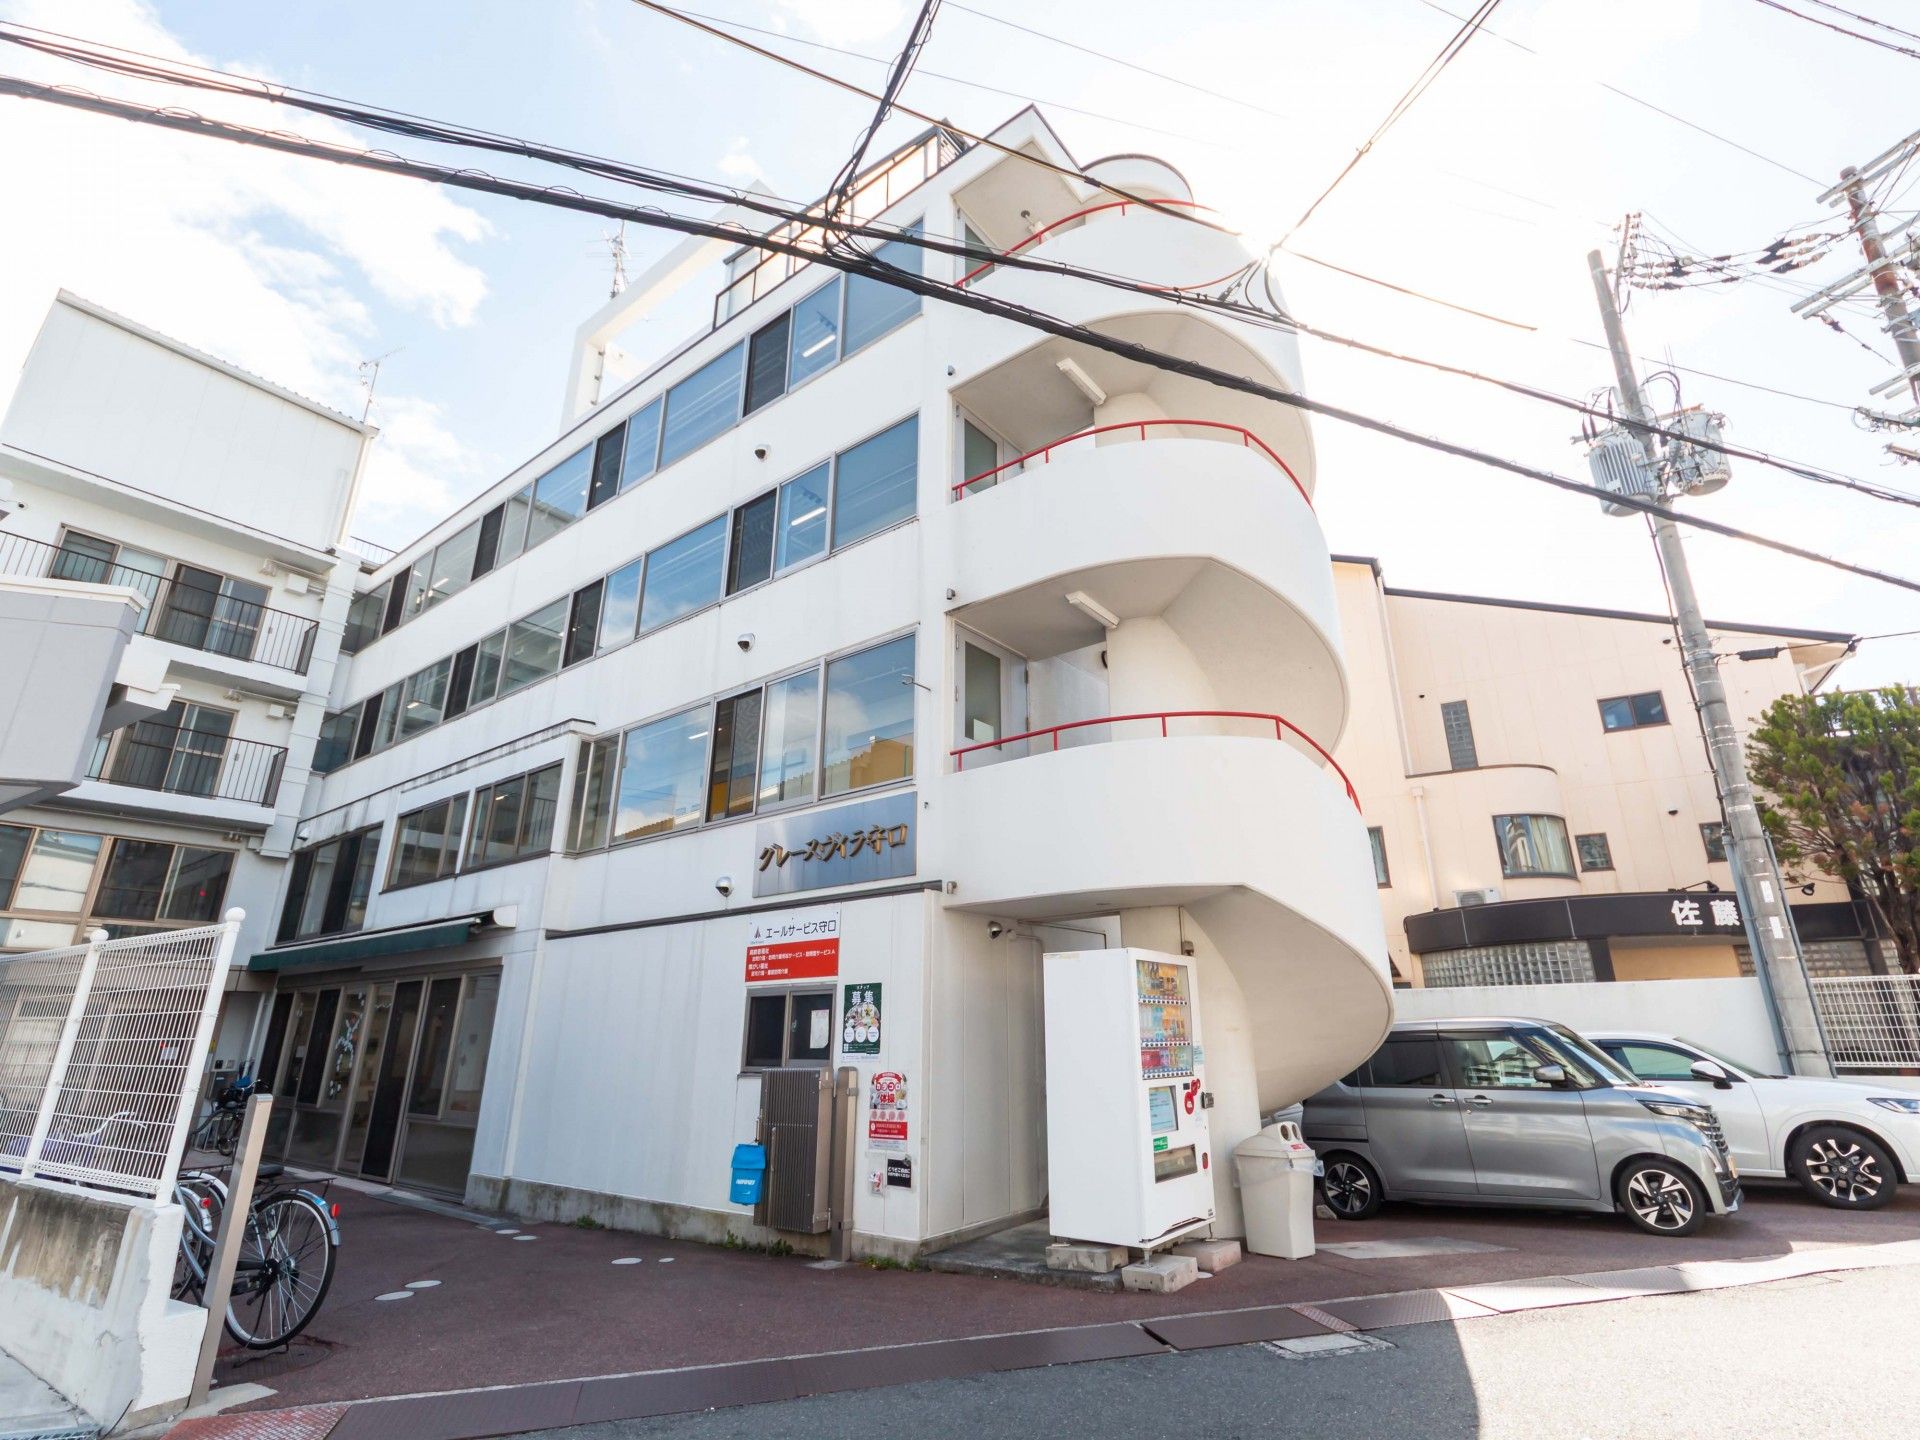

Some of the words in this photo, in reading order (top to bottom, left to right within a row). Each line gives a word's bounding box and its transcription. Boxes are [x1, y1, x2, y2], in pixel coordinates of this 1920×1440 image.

[758, 822, 908, 872] グレースヴィラ守口
[1671, 899, 1741, 926] 佐藤
[765, 919, 837, 939] エールサービス守口
[851, 990, 874, 1006] 募集
